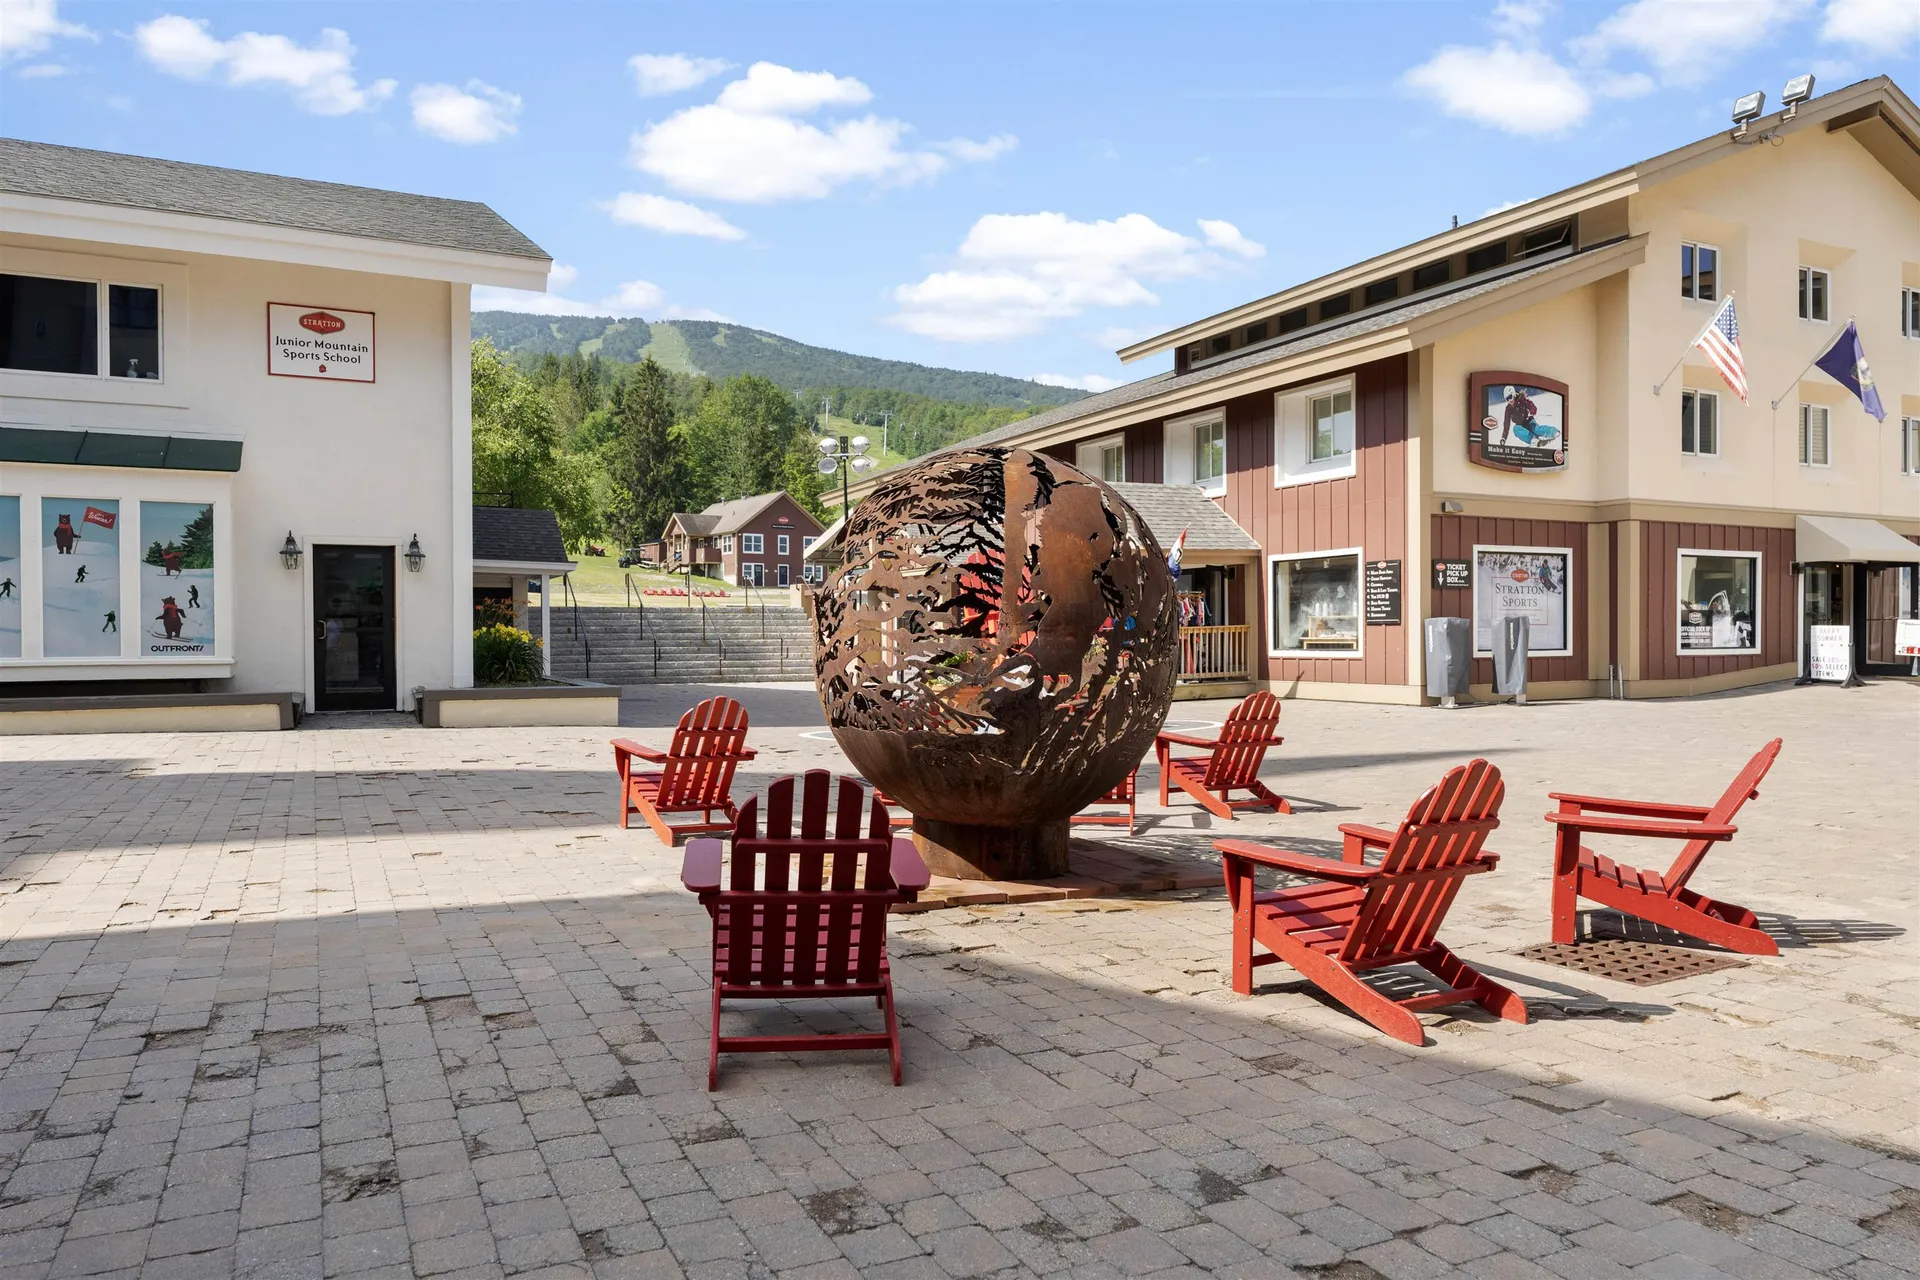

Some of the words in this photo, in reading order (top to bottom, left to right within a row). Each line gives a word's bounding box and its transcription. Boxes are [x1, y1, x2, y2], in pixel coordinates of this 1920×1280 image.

[303, 319, 341, 328] STRATTON
[276, 336, 311, 347] Junior
[314, 340, 368, 352] Mountain
[283, 348, 320, 360] Sports
[323, 352, 361, 363] School
[1495, 582, 1545, 595] STRATTON
[1502, 596, 1538, 607] SPORTS
